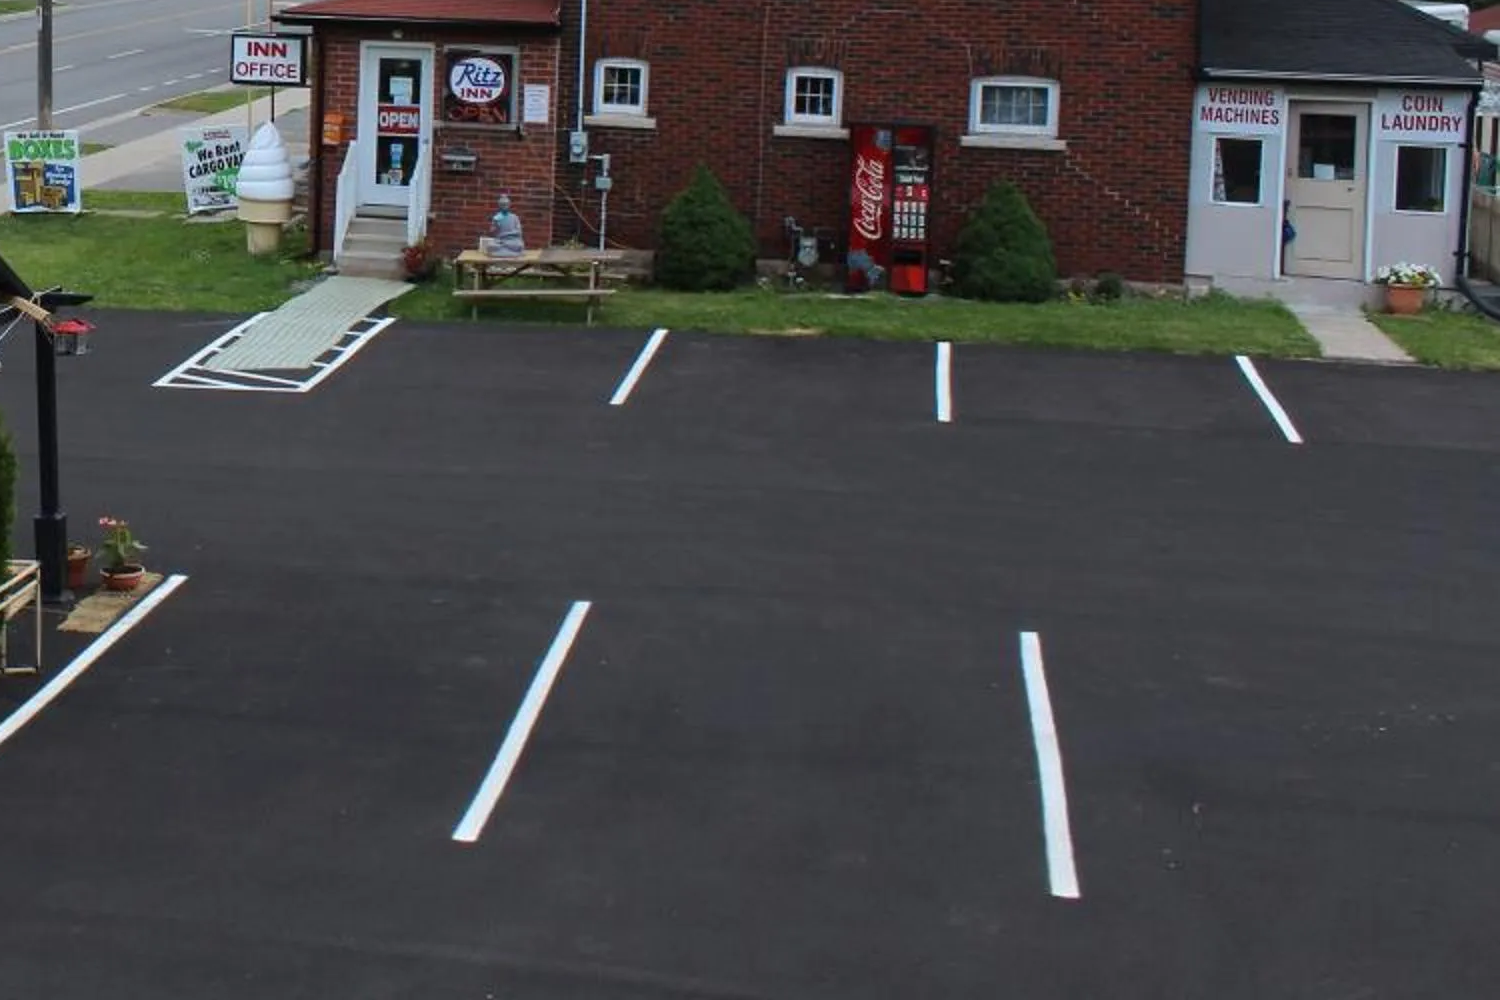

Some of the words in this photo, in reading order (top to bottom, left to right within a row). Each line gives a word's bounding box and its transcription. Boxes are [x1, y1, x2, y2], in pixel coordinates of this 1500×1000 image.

[247, 41, 287, 58] INN
[236, 61, 297, 78] OFFICE
[454, 63, 501, 87] Ritz
[461, 87, 493, 99] INN
[1208, 88, 1274, 106] VENDING
[1401, 95, 1443, 113] COIN
[379, 112, 419, 129] OPEN
[451, 105, 506, 122] OPEN
[1200, 105, 1279, 125] MACHINES
[1381, 112, 1462, 133] LAUNDRY
[197, 149, 213, 162] We
[215, 140, 240, 156] Rent
[189, 159, 224, 178] CARGO
